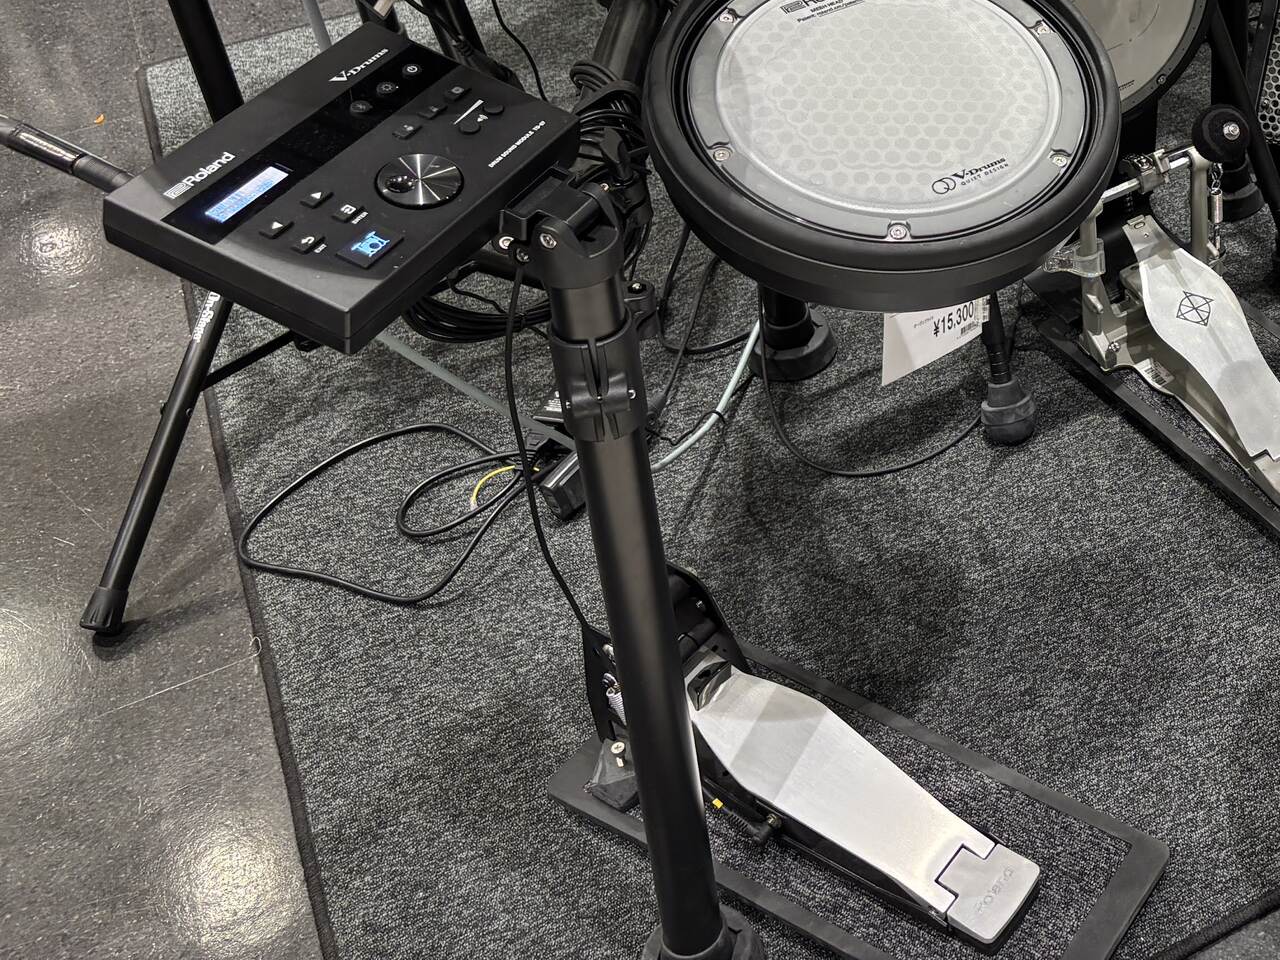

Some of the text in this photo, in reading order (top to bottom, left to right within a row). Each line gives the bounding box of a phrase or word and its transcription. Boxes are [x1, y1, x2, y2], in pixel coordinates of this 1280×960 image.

[810, 4, 828, 13] MESH
[328, 47, 389, 82] V-Drums
[184, 150, 236, 186] Roland
[951, 157, 1006, 180] V-Drums
[960, 163, 1009, 186] QUIET DESIGN
[351, 211, 368, 225] ENTER
